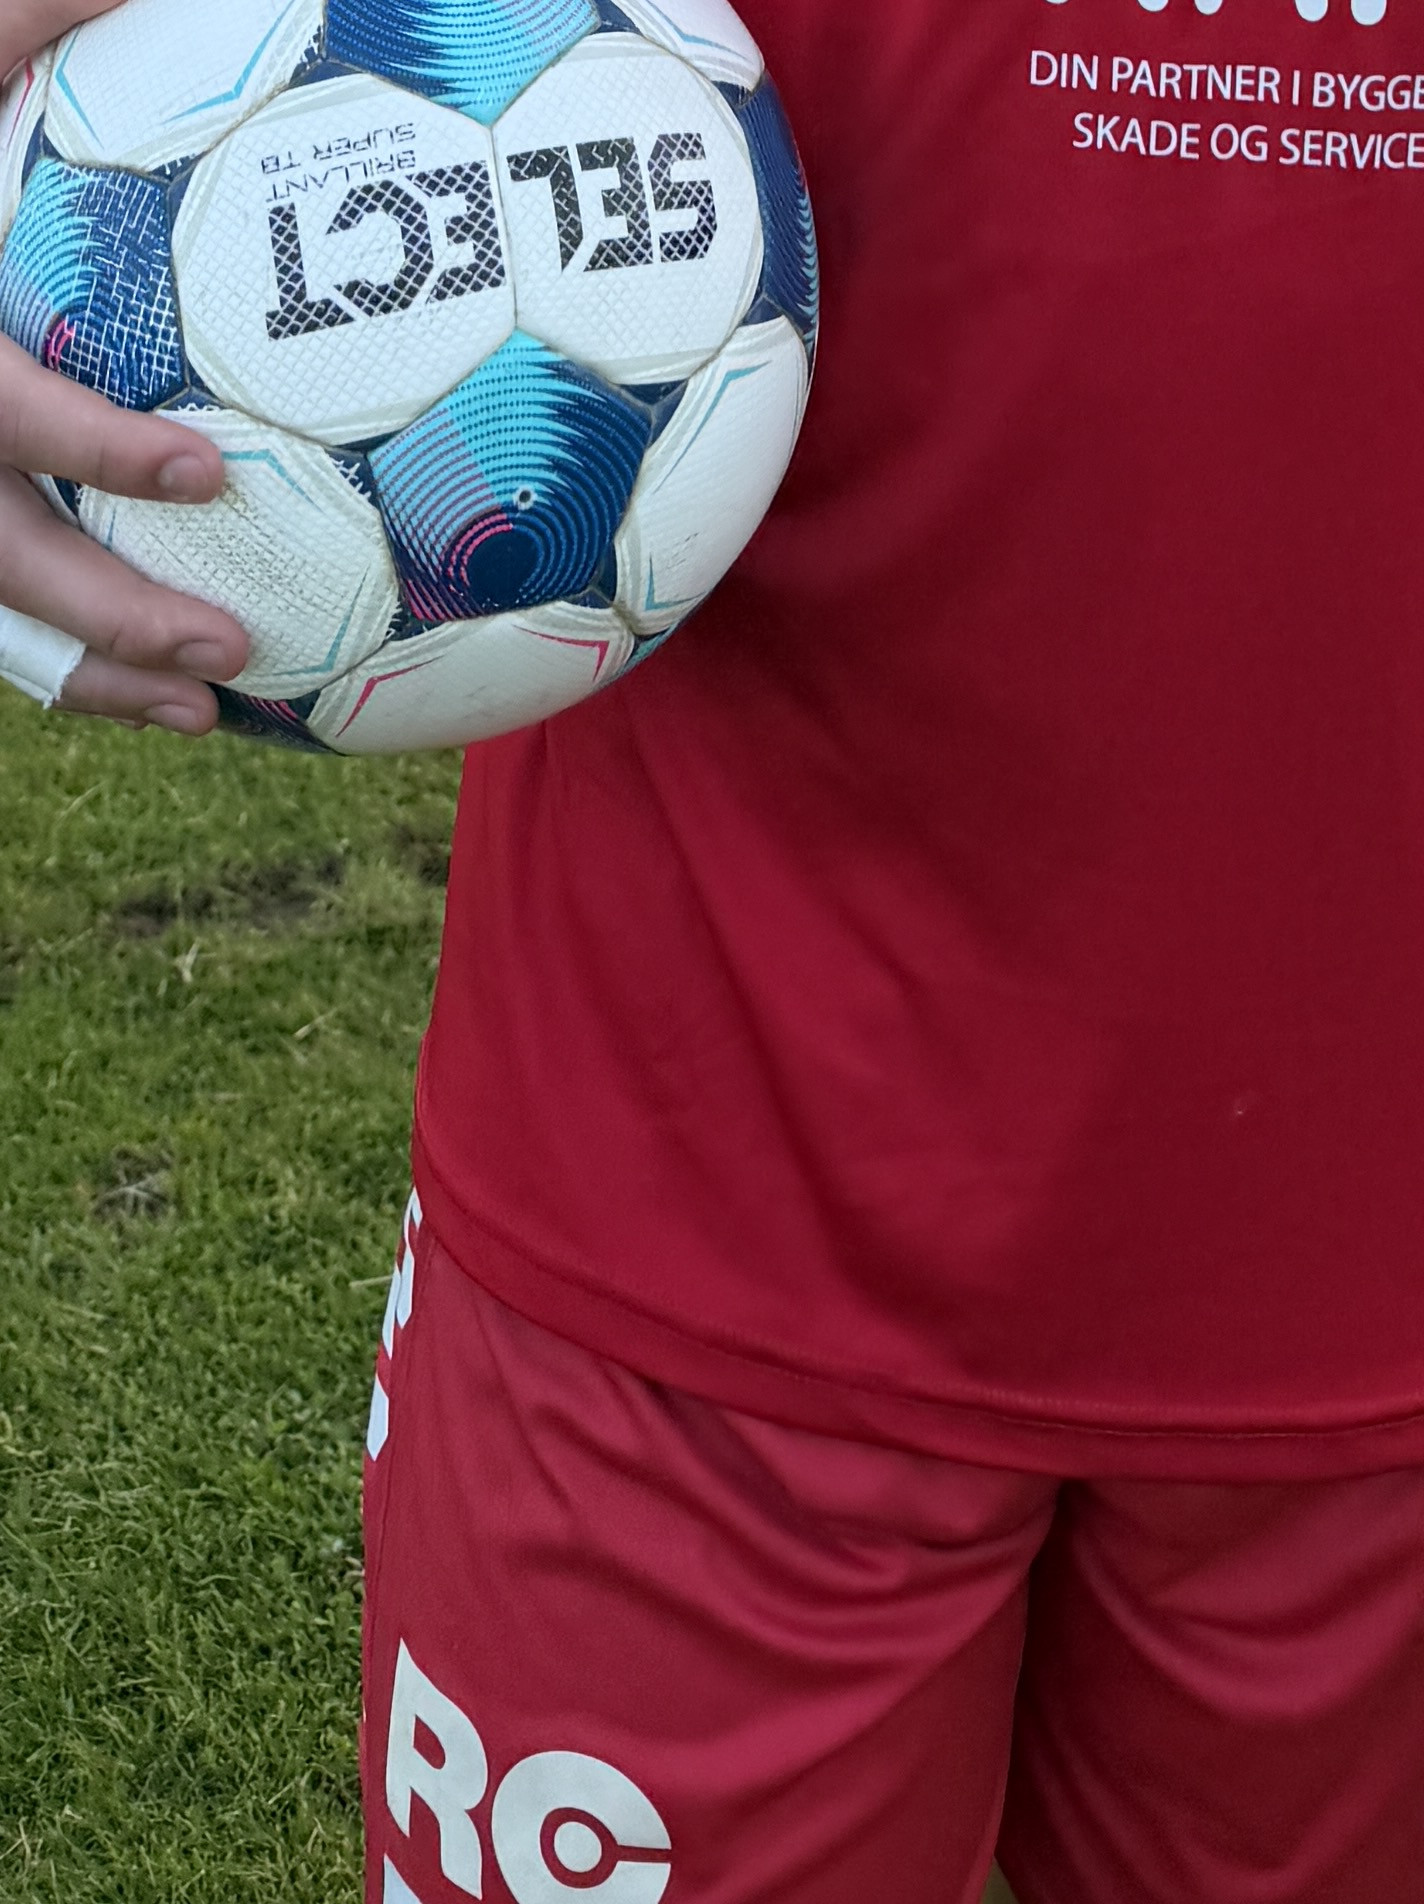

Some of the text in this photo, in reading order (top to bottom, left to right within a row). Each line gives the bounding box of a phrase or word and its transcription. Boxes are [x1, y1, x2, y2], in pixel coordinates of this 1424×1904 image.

[1029, 49, 1099, 91] DIN
[1111, 56, 1281, 106] PARTNER
[1292, 69, 1301, 106] I
[311, 122, 417, 162] SUPER
[1072, 111, 1202, 161] SKADE
[1209, 122, 1269, 163] OG
[265, 149, 417, 203] BRILLANT
[265, 132, 719, 341] SELECT
[385, 1636, 673, 1904] RC
